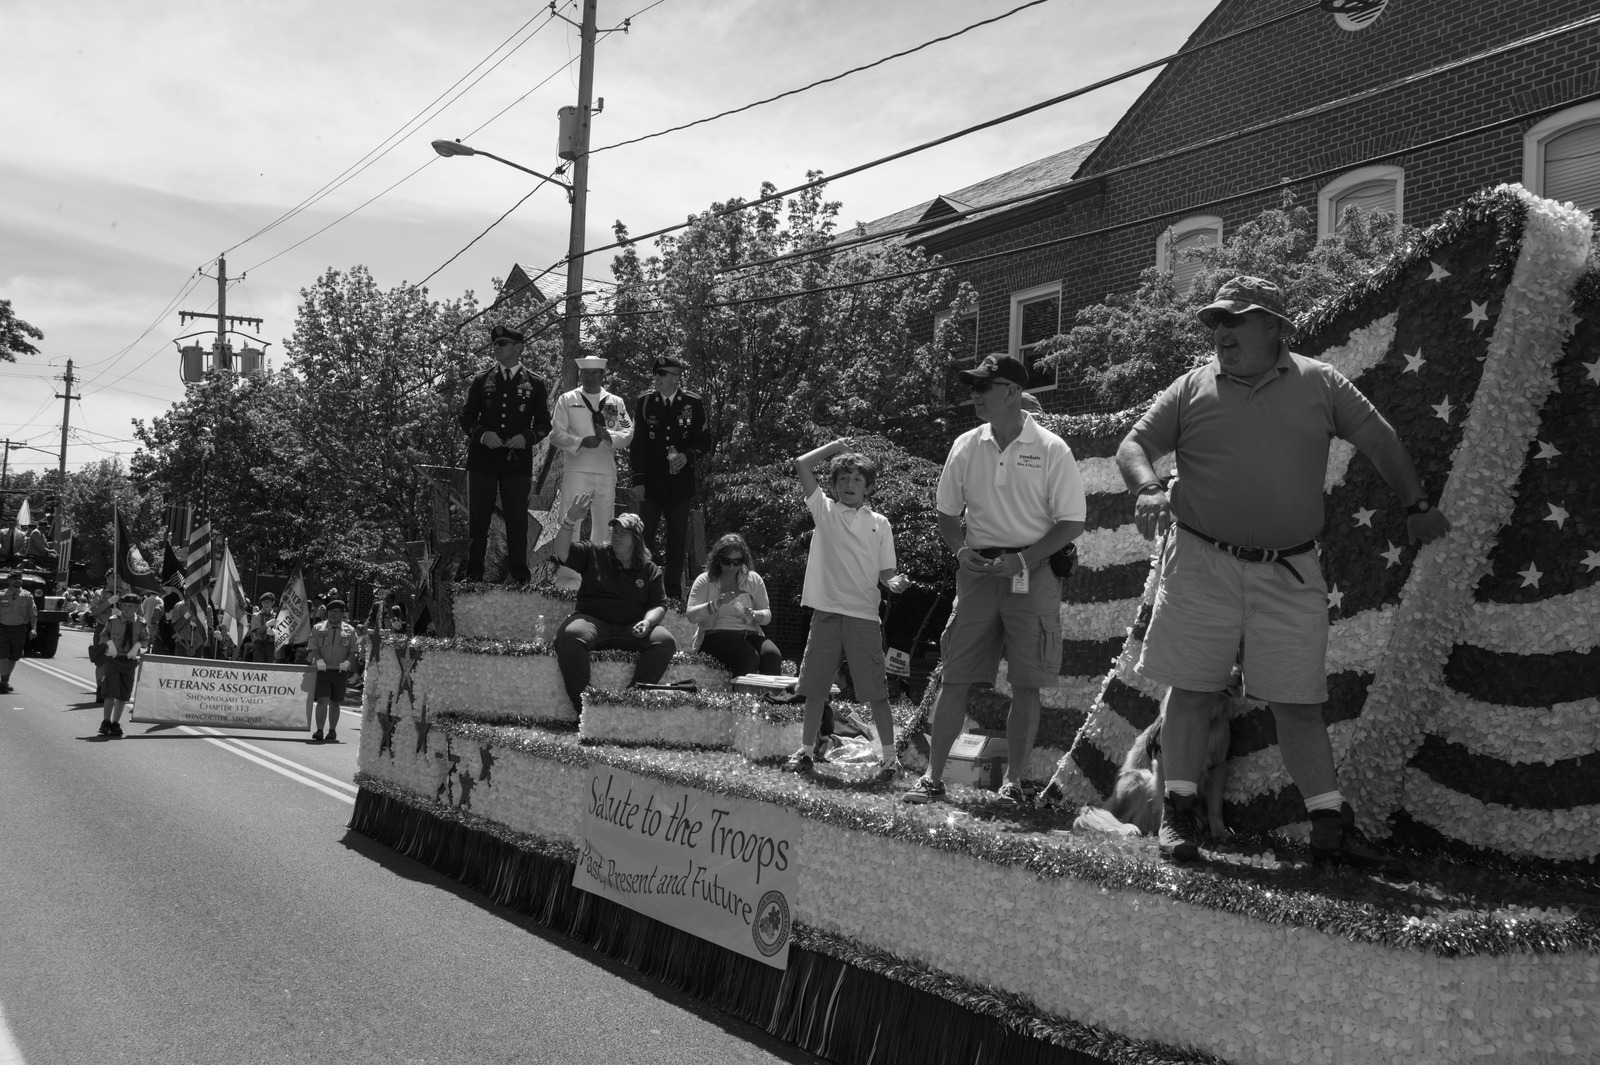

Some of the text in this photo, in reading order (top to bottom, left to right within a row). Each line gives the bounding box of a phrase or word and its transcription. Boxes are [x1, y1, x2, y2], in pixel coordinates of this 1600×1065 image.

[889, 655, 906, 666] PARKING
[191, 668, 268, 682] KOREAN WAR
[158, 678, 296, 695] VETERANS ASSOCIATION
[186, 692, 265, 705] SHENANDOAH VALLEY
[199, 702, 250, 712] CHAPTER 313
[232, 715, 262, 723] VIRGINIA
[588, 774, 790, 884] Salute to the Troops
[579, 838, 606, 890] Past,
[607, 859, 657, 894] Present
[656, 859, 692, 896] and
[692, 866, 753, 926] Future
